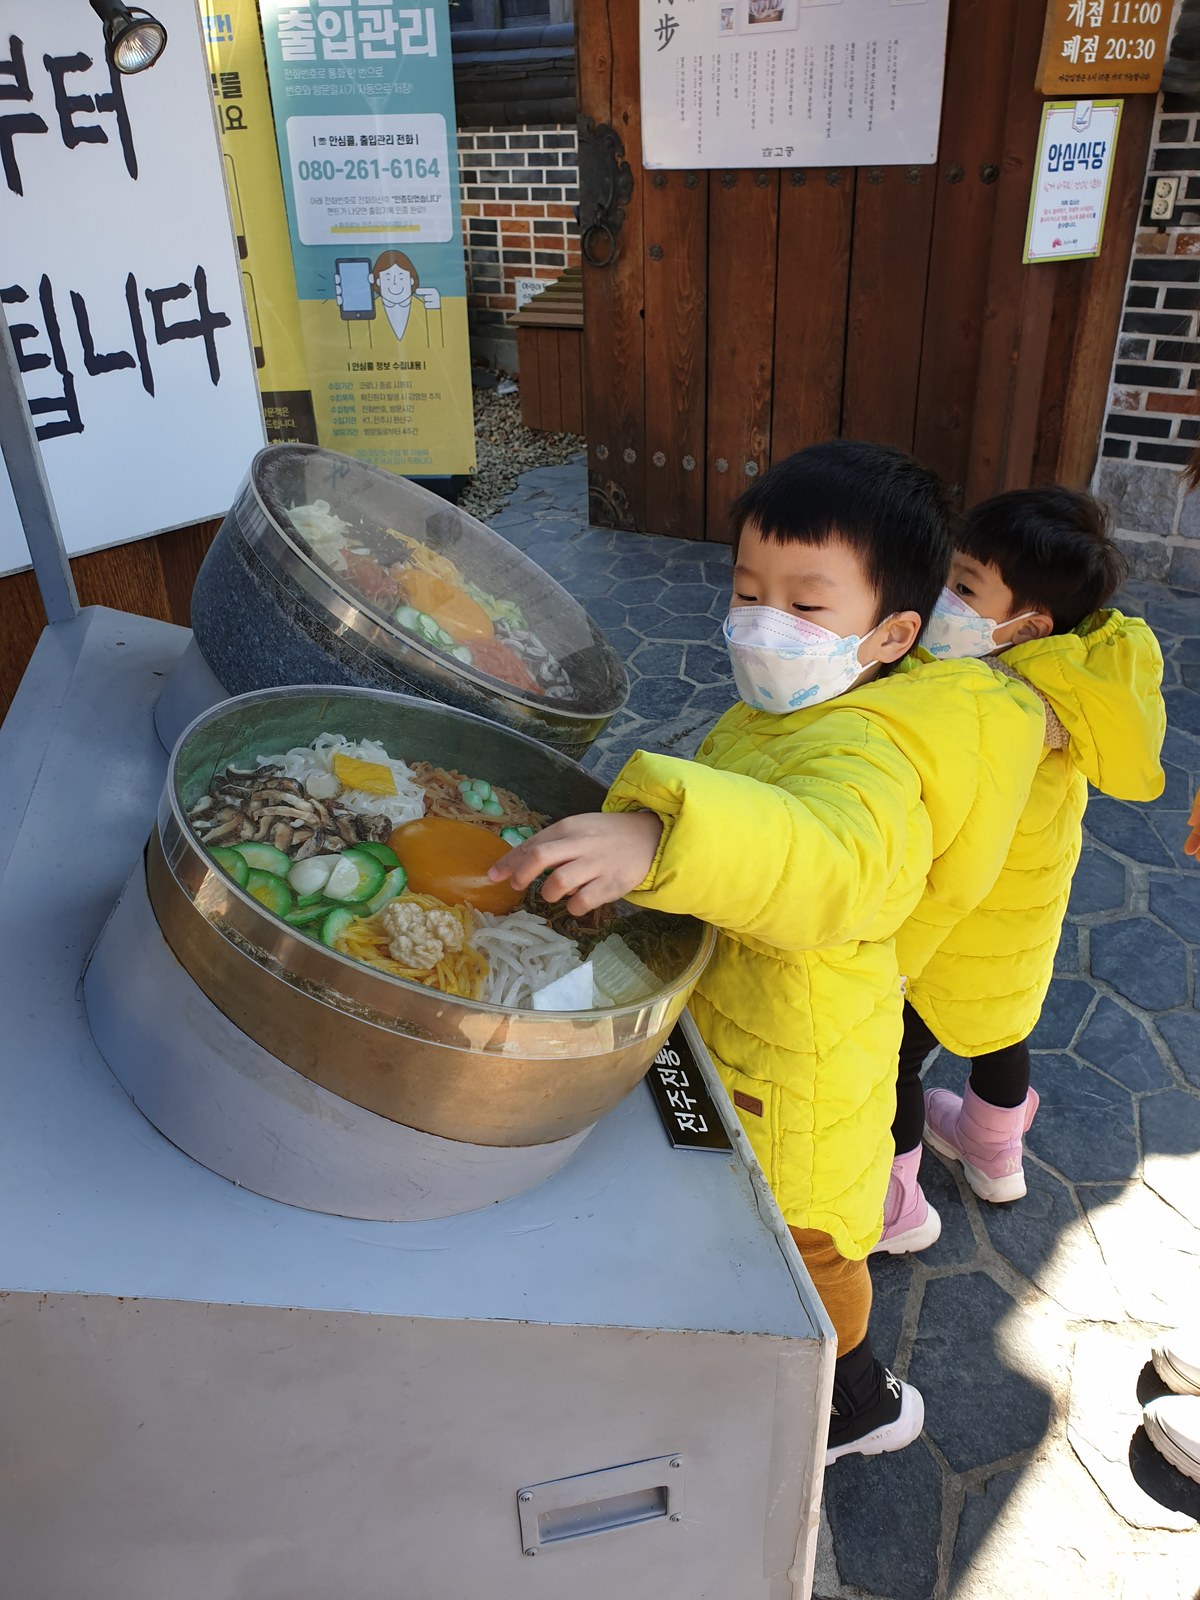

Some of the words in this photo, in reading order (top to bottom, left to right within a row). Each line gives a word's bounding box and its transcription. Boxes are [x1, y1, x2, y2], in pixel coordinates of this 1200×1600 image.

[1066, 0, 1104, 28] 개점
[1111, 1, 1161, 24] 11:00
[277, 7, 437, 61] 출입관리
[1061, 35, 1100, 64] 폐점
[1104, 38, 1156, 60] 20:30
[284, 68, 326, 80] 전화번호로
[328, 67, 345, 79] 통화
[358, 66, 384, 78] 번으로
[285, 85, 311, 97] 번호와
[358, 83, 392, 95] 자동으로
[329, 135, 358, 147] 안심콜,
[360, 135, 394, 147] 출입관리
[397, 134, 414, 145] 전화
[1048, 141, 1106, 172] 안심식당
[298, 158, 440, 181] 080-261-6164
[352, 361, 374, 372] 안심콜
[376, 361, 391, 371] 정보
[392, 361, 422, 371] 수집내용
